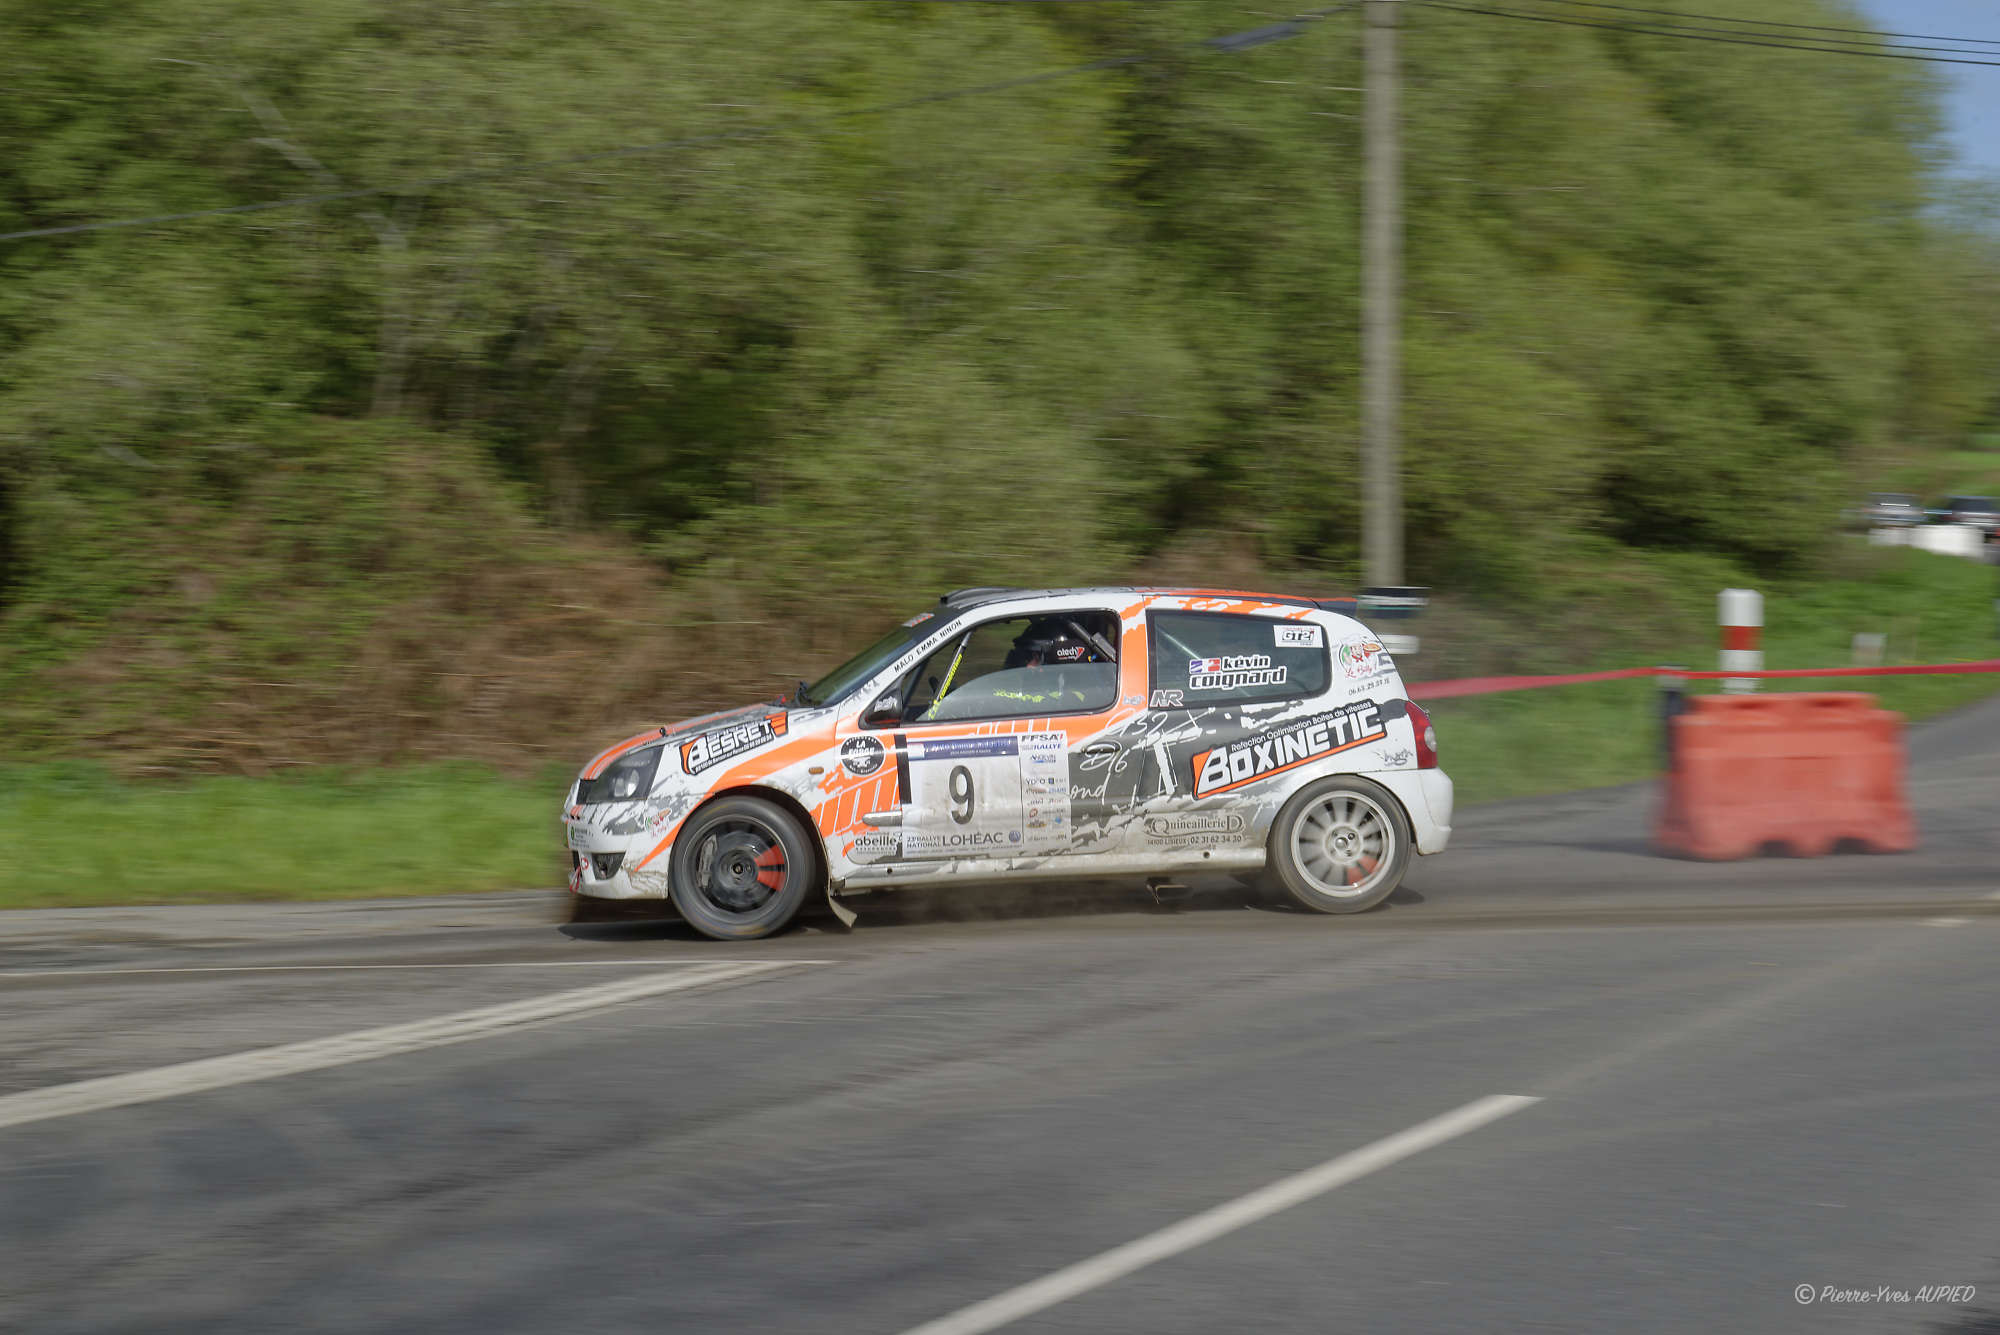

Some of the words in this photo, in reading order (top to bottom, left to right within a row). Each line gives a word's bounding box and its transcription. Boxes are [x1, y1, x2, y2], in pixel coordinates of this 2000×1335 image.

[894, 654, 914, 673] MALO
[916, 637, 938, 655] EMMA
[939, 619, 962, 638] NINON
[1190, 667, 1285, 688] coignard
[1267, 720, 1312, 740] Optimisation
[1335, 709, 1345, 718] de
[1345, 702, 1372, 715] vitesses
[688, 719, 772, 773] BESRET
[856, 740, 866, 748] LA
[1021, 734, 1059, 742] FFSA
[1196, 708, 1382, 794] BOXINETIC
[948, 764, 975, 825] 9
[942, 832, 1004, 847] LOHÉAC
[1152, 818, 1226, 834] Quincaillerie
